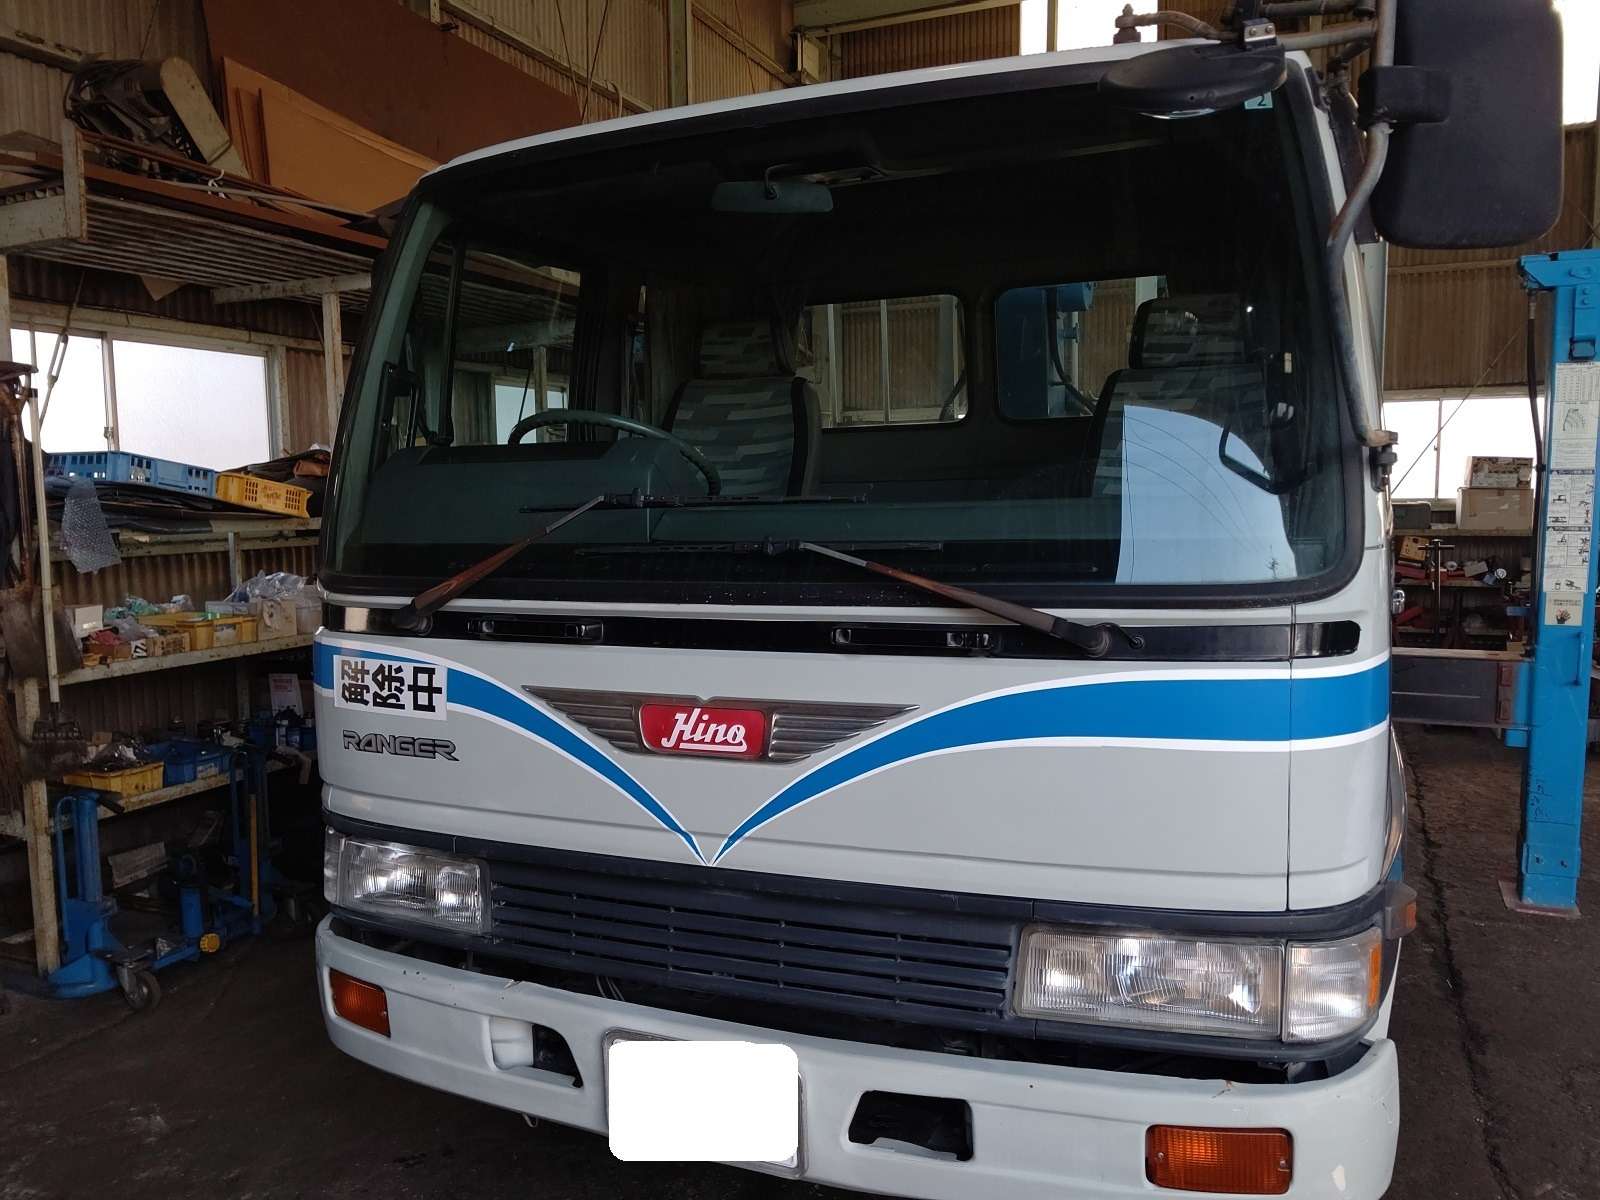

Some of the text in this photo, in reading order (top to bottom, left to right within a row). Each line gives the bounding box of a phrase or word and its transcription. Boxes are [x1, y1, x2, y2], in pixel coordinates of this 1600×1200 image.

[341, 659, 443, 713] 解除中
[342, 729, 460, 762] RANGER
[660, 707, 748, 753] Hino
